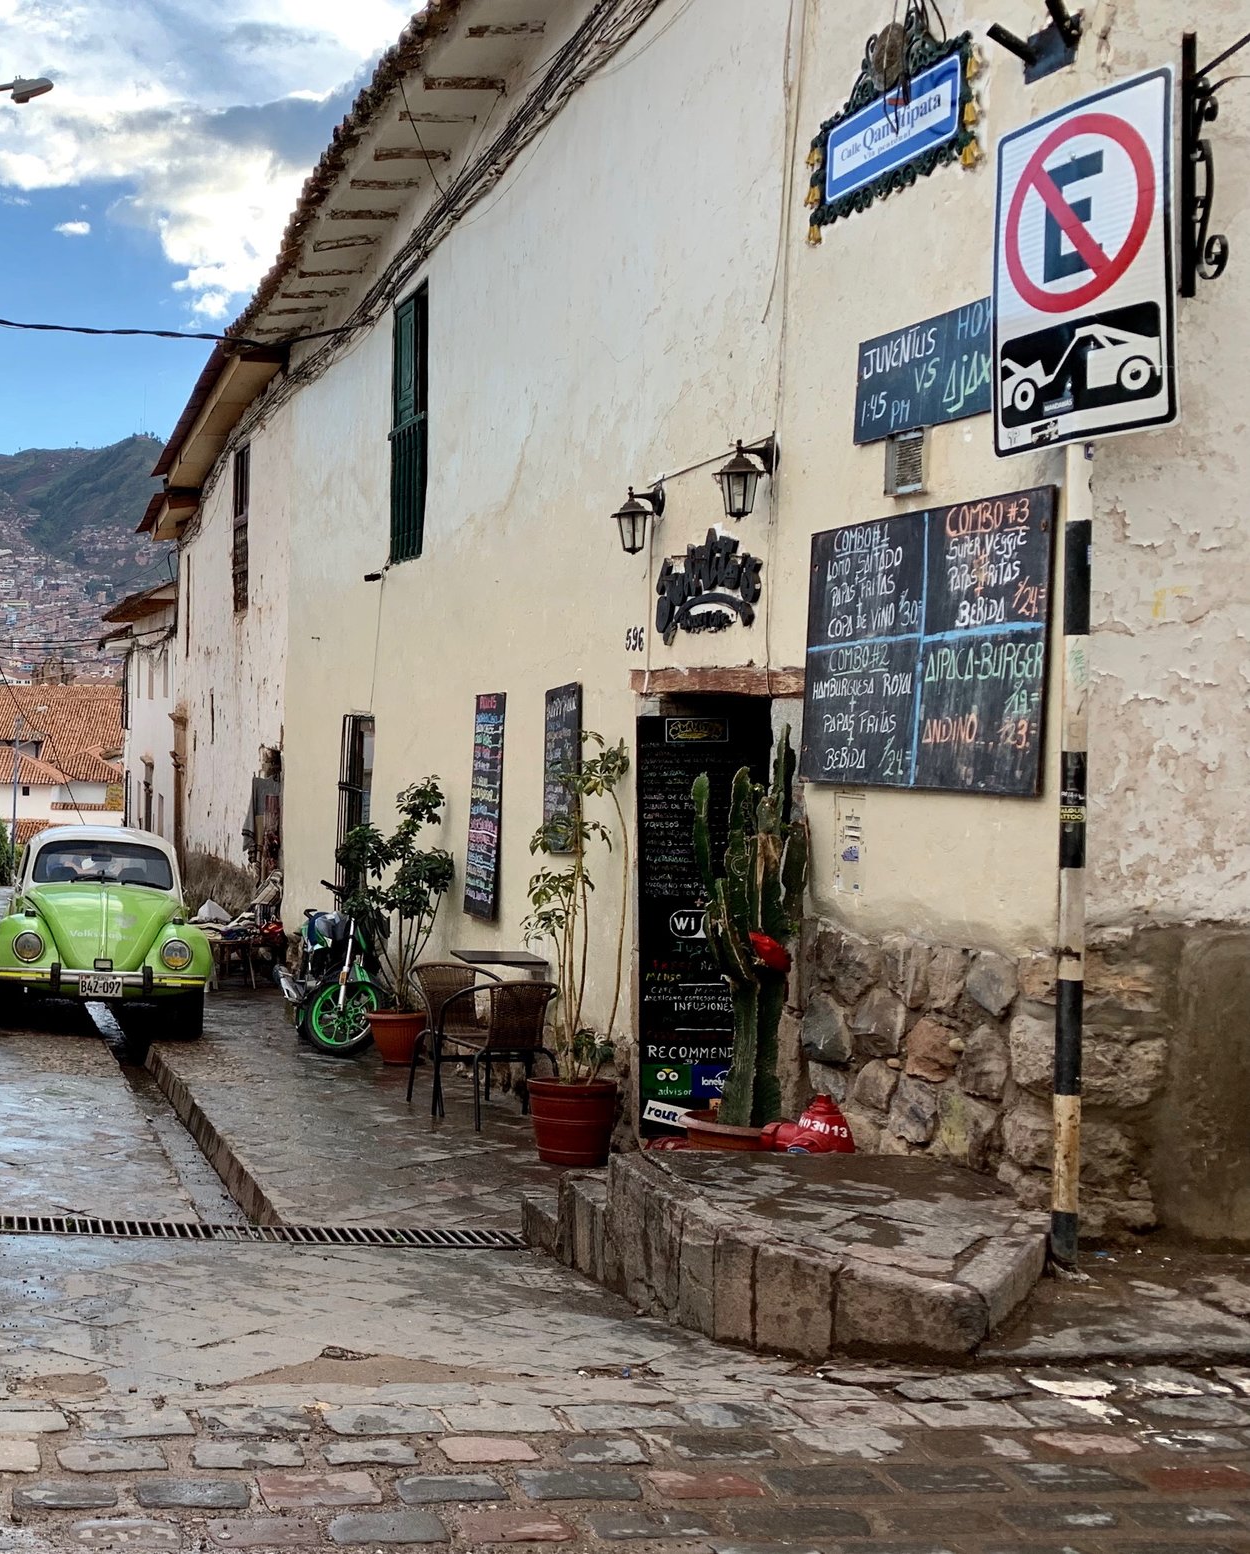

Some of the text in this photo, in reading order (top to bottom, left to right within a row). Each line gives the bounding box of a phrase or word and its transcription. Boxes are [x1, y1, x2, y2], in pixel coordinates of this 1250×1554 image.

[841, 94, 941, 161] Calle Qanhipata
[1043, 149, 1104, 284] E
[863, 326, 938, 380] JUVENTUS
[915, 357, 940, 393] VS
[861, 391, 911, 430] 1:45 PM
[946, 498, 1030, 536] COMBO #3
[945, 535, 981, 560] SUPER
[947, 564, 978, 592] PAPAS
[830, 582, 856, 607] PAPAS
[828, 615, 853, 638] COPA
[856, 613, 867, 629] DE
[625, 627, 645, 652] 596
[829, 645, 870, 672] COMBO
[812, 677, 874, 700] HAMBURGUESA
[823, 712, 855, 733] PAPAS
[657, 1087, 693, 1096] advisor
